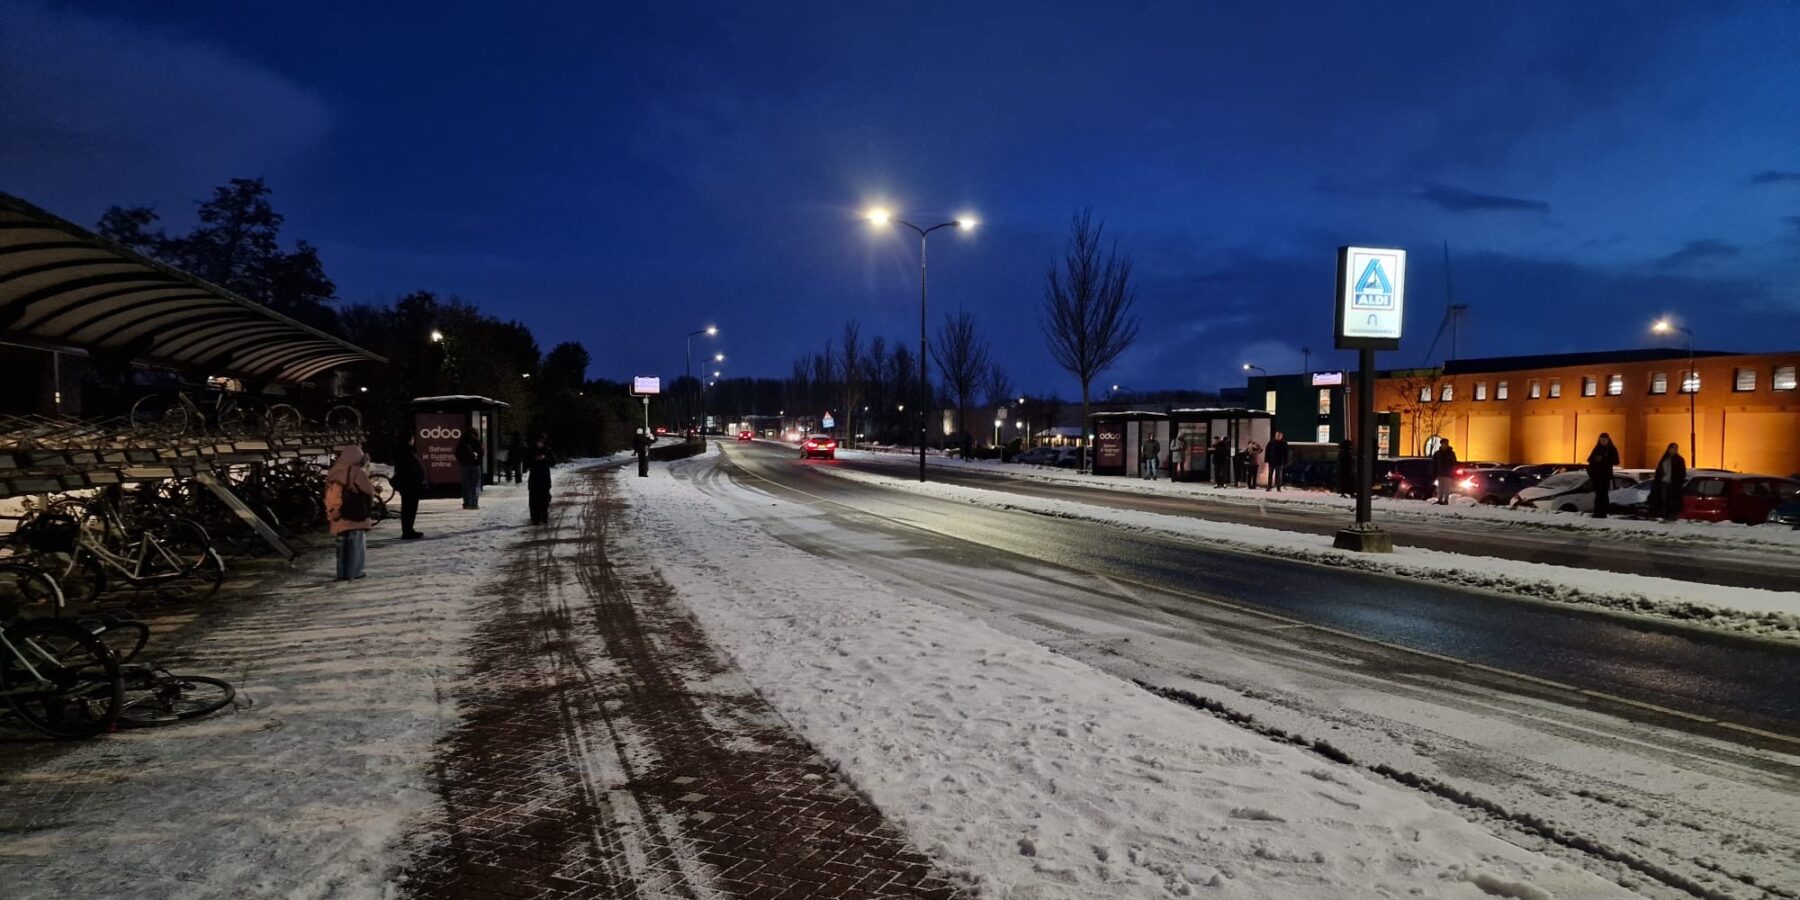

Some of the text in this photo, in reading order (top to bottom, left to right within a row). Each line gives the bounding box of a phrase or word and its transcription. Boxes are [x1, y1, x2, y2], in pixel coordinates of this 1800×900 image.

[1358, 294, 1388, 305] ALDI
[420, 425, 461, 439] odoo
[1099, 432, 1121, 440] odoo
